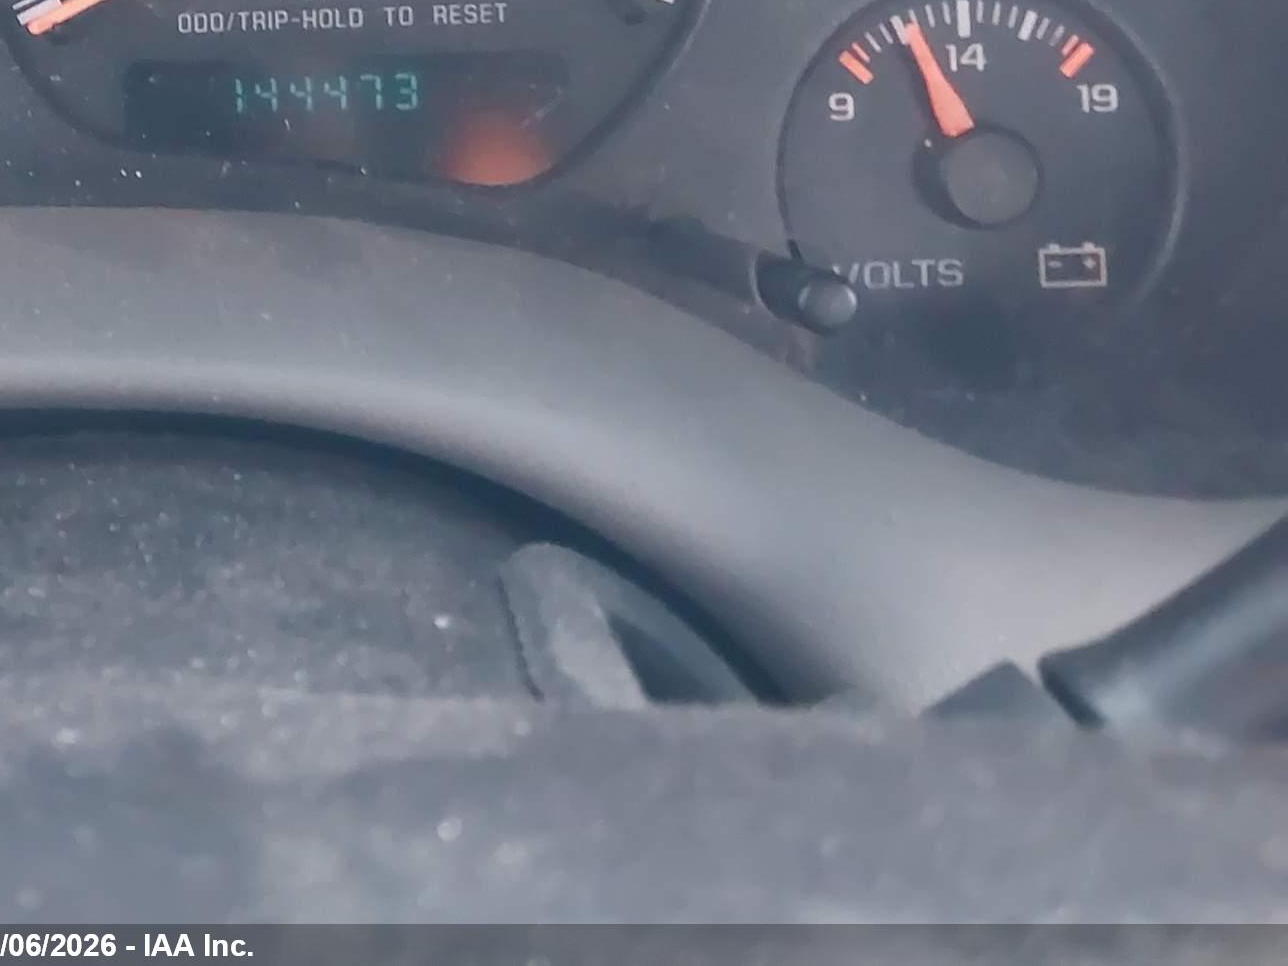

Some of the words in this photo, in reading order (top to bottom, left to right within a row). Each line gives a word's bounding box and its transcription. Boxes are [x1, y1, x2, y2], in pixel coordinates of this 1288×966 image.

[177, 7, 364, 34] ODO/TRIP-HOLD
[383, 6, 414, 26] TO
[432, 2, 508, 26] RESET
[945, 43, 987, 72] 14
[234, 72, 418, 114] 144473
[827, 92, 855, 121] 9
[1076, 84, 1118, 113] 19
[831, 257, 965, 289] VOLTS
